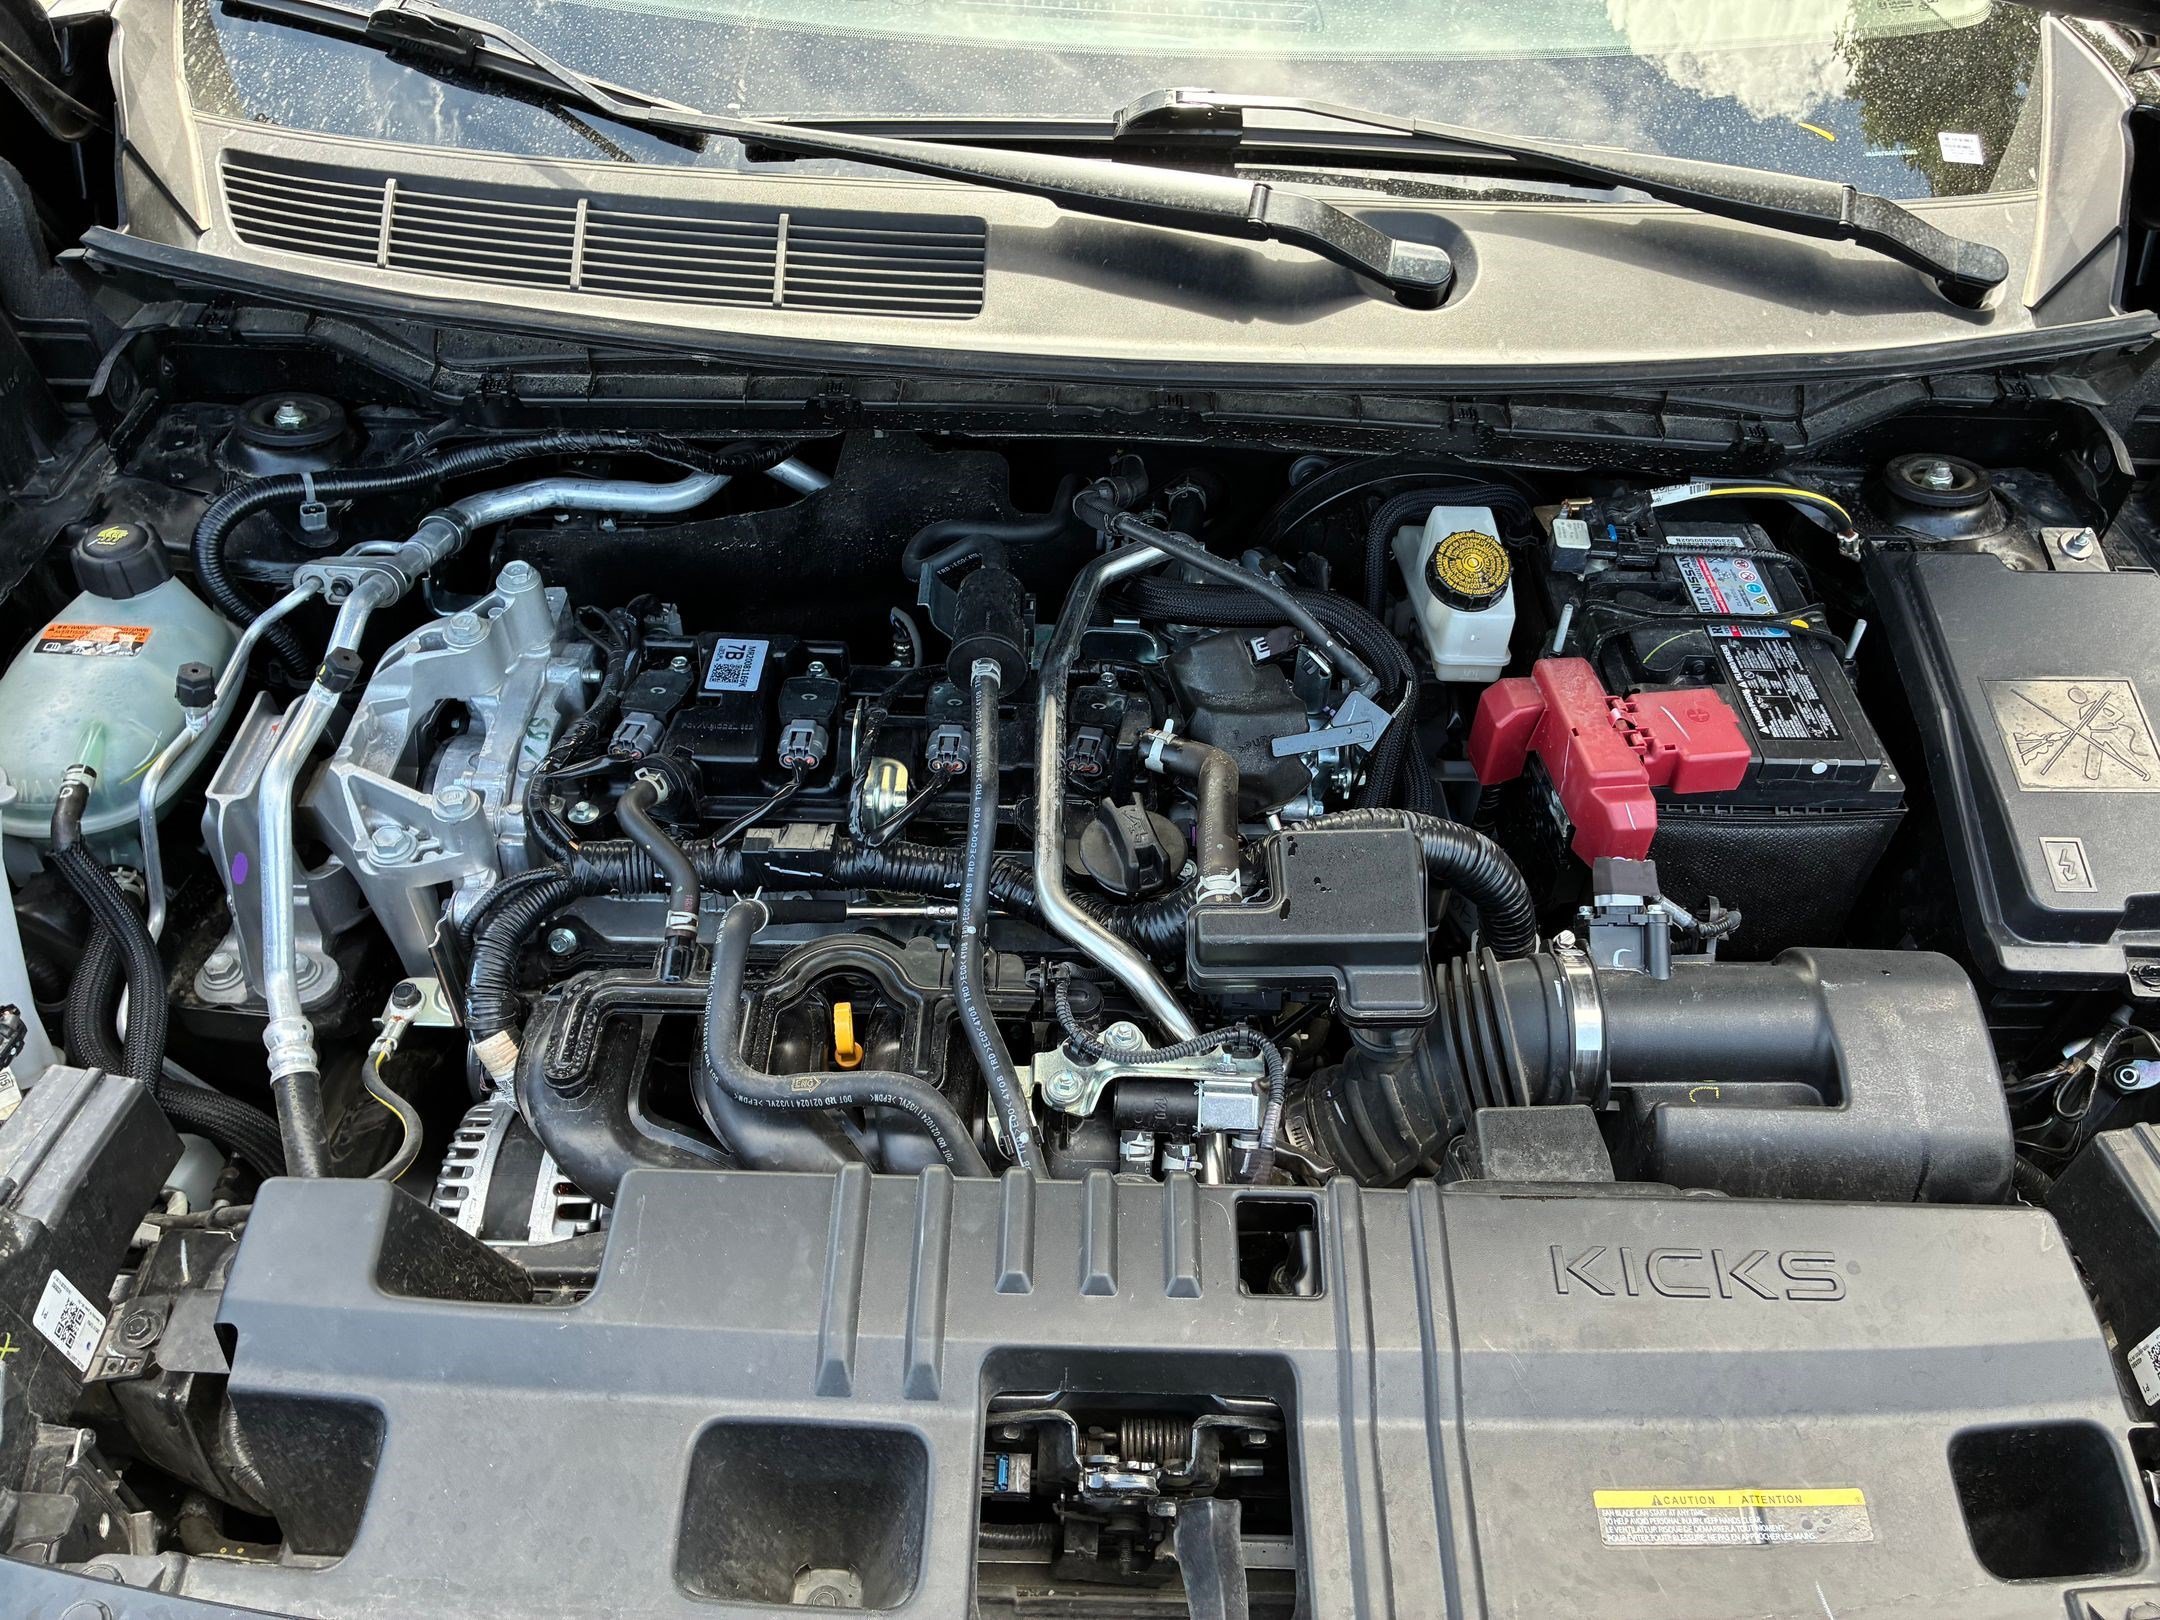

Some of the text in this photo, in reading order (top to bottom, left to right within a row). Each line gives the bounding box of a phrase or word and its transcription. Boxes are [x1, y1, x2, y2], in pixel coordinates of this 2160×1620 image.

[725, 645, 747, 660] 7B
[920, 1113, 940, 1137] 021024
[1549, 1245, 1846, 1301] KICKS
[1664, 1495, 1716, 1505] CAUTION
[1741, 1494, 1803, 1505] ATTENTION
[1636, 1509, 1649, 1517] CAN
[1649, 1508, 1667, 1516] START
[1614, 1517, 1629, 1525] HELP
[1630, 1517, 1649, 1525] AVOID
[1615, 1526, 1658, 1534] VENTILATEUR
[1659, 1525, 1682, 1533] RISQUE
[1737, 1525, 1756, 1533] TOUT
